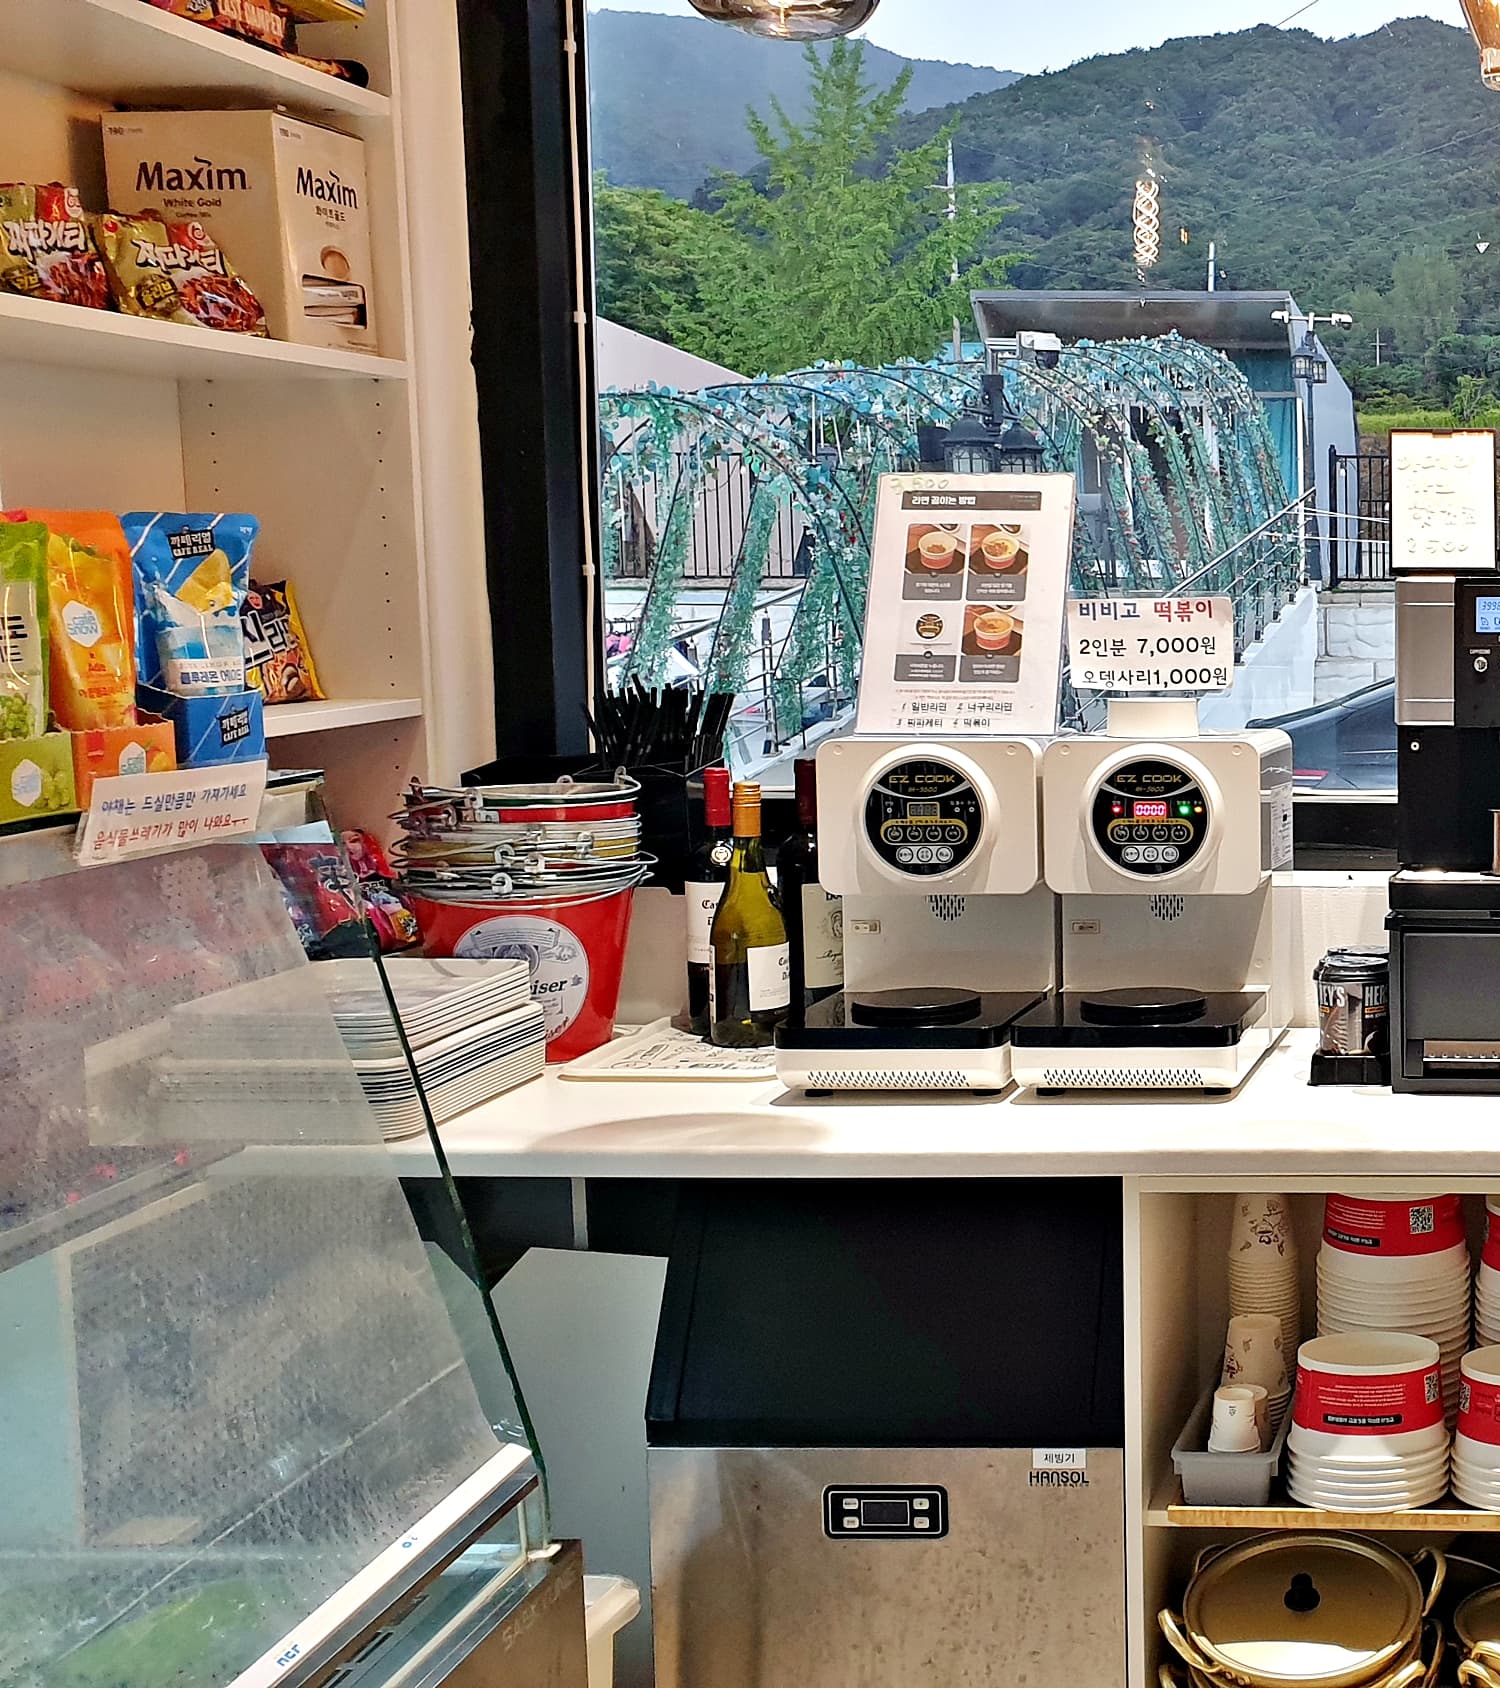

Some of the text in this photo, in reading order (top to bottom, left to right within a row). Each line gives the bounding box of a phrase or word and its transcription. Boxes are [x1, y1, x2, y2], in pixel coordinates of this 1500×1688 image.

[136, 156, 247, 191] Maxim
[296, 167, 358, 210] Maxim
[131, 239, 227, 275] 짜파게티
[1079, 599, 1214, 623] 비비고 떡볶이
[1079, 636, 1217, 658] 2인분 7,000원
[889, 774, 956, 783] EZ COOK
[1116, 774, 1182, 783] EZ COOK
[101, 797, 137, 816] 야채는
[1043, 1452, 1075, 1464] 제빙기
[1029, 1471, 1090, 1484] HANSOL
